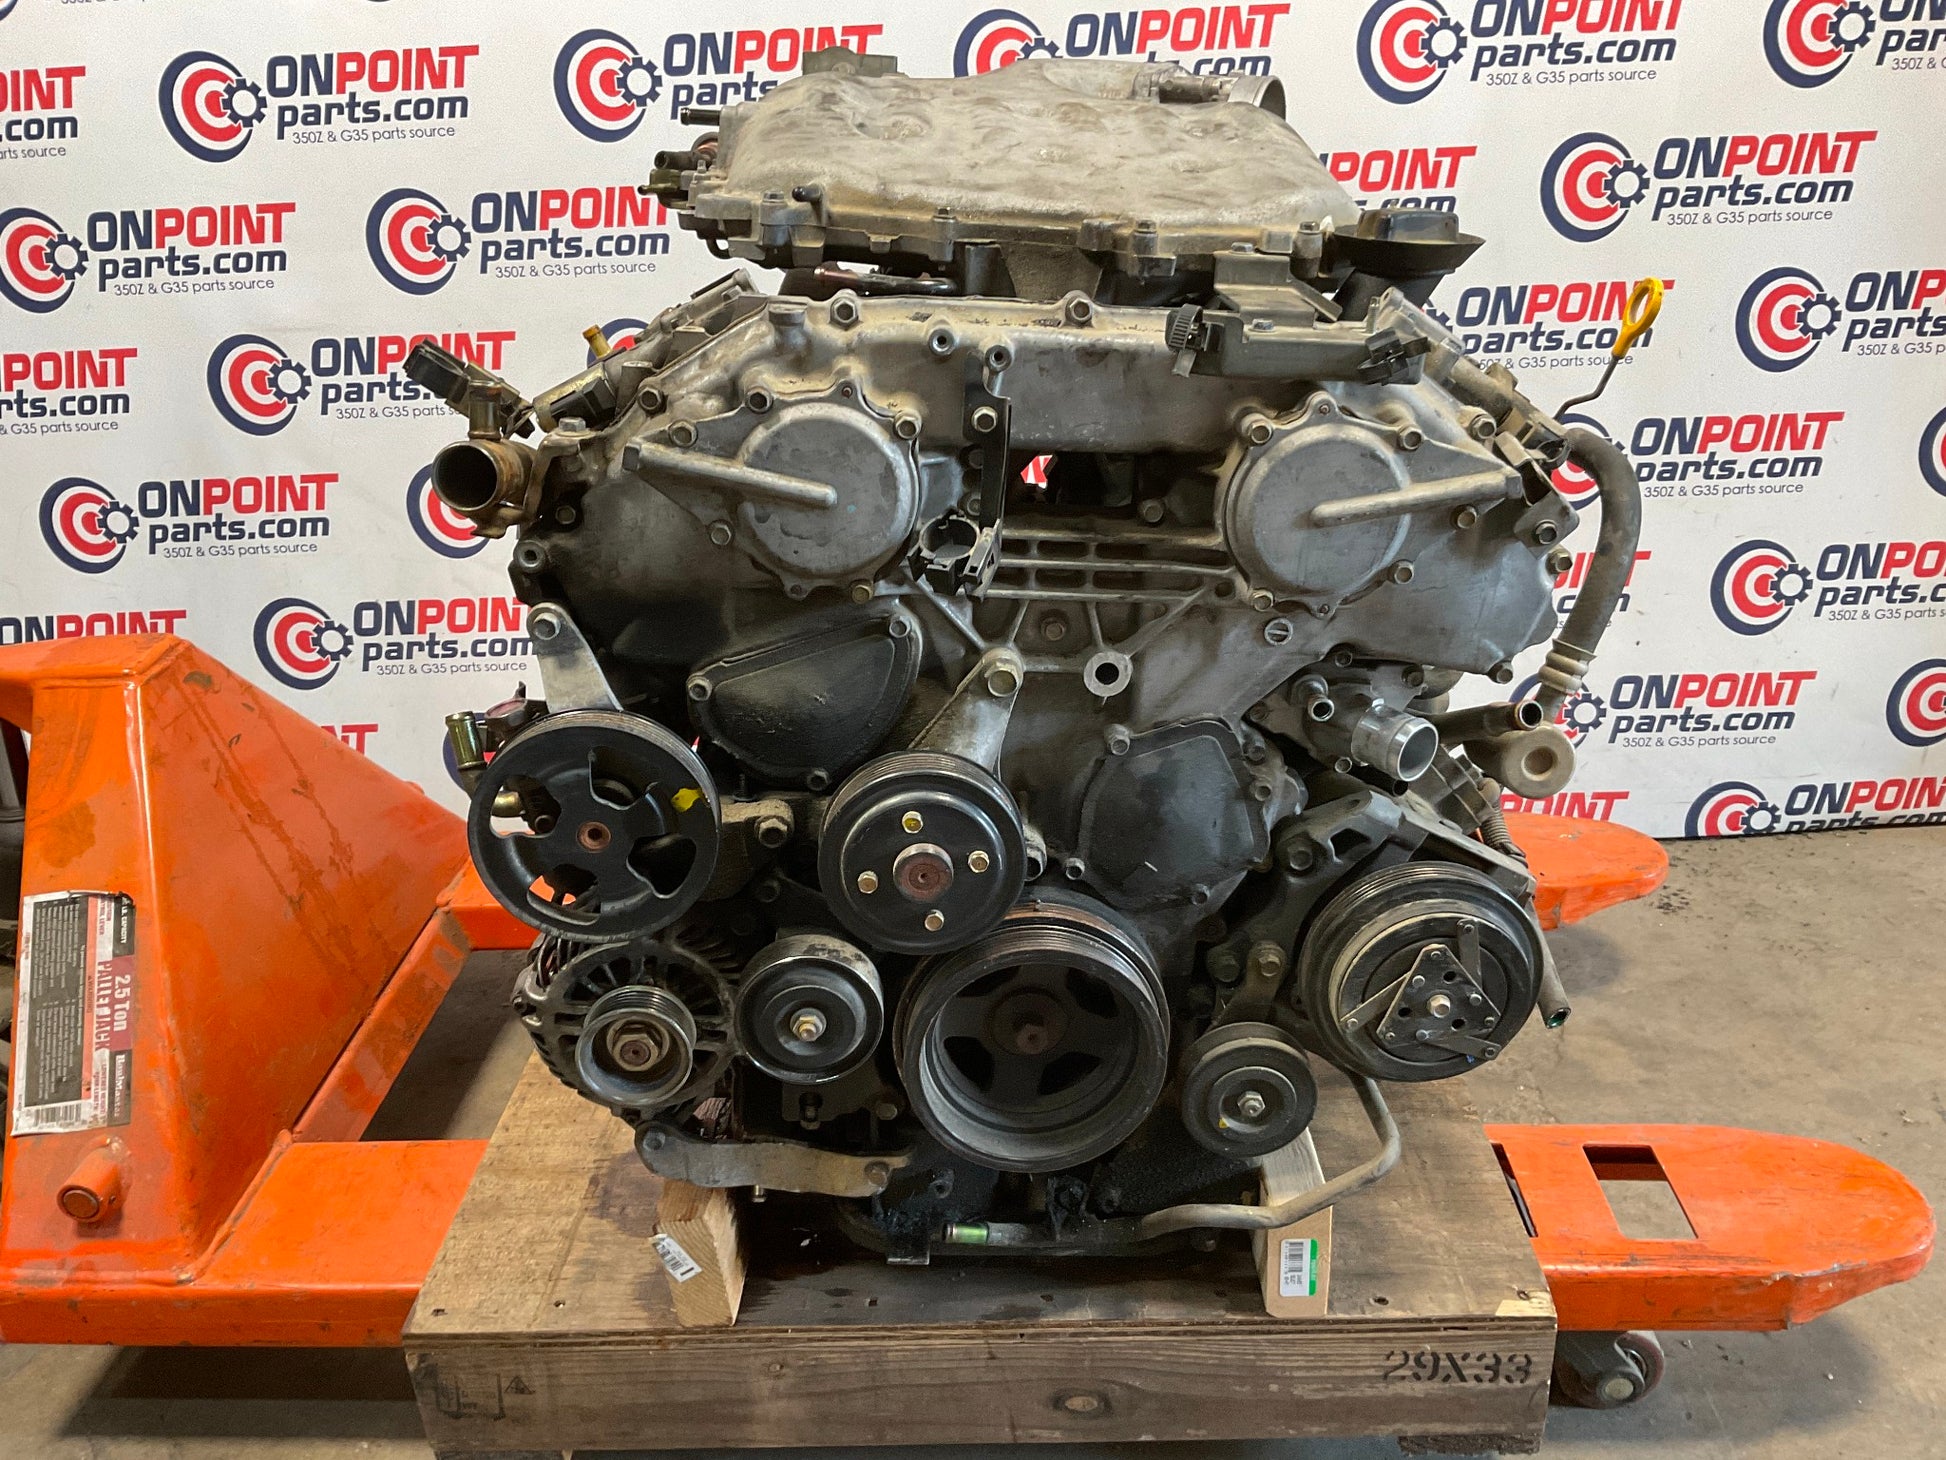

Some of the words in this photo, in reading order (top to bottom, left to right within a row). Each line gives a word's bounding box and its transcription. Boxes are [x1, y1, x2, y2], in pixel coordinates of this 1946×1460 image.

[1065, 3, 1291, 57] ONPOINT
[266, 44, 479, 98] ONPOINT
[1470, 32, 1677, 82] parts.com
[1892, 57, 1923, 70] 350Z
[1486, 73, 1518, 86] 350Z
[1522, 72, 1532, 84] &
[1536, 71, 1565, 84] G35
[1569, 69, 1604, 85] parts
[1608, 69, 1657, 81] source
[277, 92, 468, 140] parts.com
[22, 146, 66, 159] source
[292, 131, 323, 144] 350Z
[327, 130, 337, 142] &
[340, 128, 369, 142] G35
[372, 127, 406, 145] parts
[409, 126, 455, 138] source
[1319, 146, 1478, 192] POINT
[1653, 130, 1878, 179] ONPOINT
[1651, 174, 1854, 221] parts.com
[87, 202, 296, 252] ONPOINT
[1667, 213, 1699, 225] 350Z
[1703, 212, 1712, 224] &
[1716, 211, 1744, 224] G35
[1748, 209, 1782, 225] parts
[1786, 210, 1833, 222] source
[99, 246, 287, 292] parts.com
[480, 228, 670, 275] parts.com
[114, 283, 144, 296] 350Z
[148, 282, 158, 294] &
[160, 281, 189, 294] G35
[192, 280, 226, 297] parts
[229, 278, 274, 291] source
[496, 266, 525, 278] 350Z
[529, 266, 539, 277] &
[542, 264, 570, 277] G35
[574, 262, 607, 278] parts
[611, 262, 656, 274] source
[1505, 357, 1515, 369] &
[1518, 356, 1546, 368] G35
[1550, 355, 1584, 370] parts
[1857, 344, 1888, 356] 350Z
[1891, 343, 1899, 354] &
[1904, 342, 1933, 354] G35
[11, 423, 37, 435] G35
[40, 421, 72, 436] parts
[75, 421, 118, 432] source
[336, 408, 366, 419] 350Z
[369, 407, 379, 417] &
[382, 406, 409, 417] G35
[413, 405, 445, 419] parts
[1630, 411, 1845, 456] ONPOINT
[138, 473, 339, 518] ONPOINT
[1644, 486, 1674, 498] 350Z
[1678, 486, 1687, 497] &
[1691, 485, 1719, 496] G35
[1722, 484, 1756, 497] parts
[1758, 483, 1804, 494] source
[149, 513, 330, 555] parts.com
[164, 547, 193, 558] 350Z
[196, 546, 205, 556] &
[208, 545, 235, 556] G35
[238, 544, 271, 557] parts
[274, 543, 318, 554] source
[353, 597, 531, 637] ONPOIN
[1828, 609, 1857, 621] 350Z
[1861, 609, 1870, 620] &
[1874, 608, 1902, 620] G35
[1904, 607, 1936, 620] parts
[362, 632, 537, 672] parts.com
[376, 665, 404, 676] 350Z
[409, 664, 417, 674] &
[421, 663, 447, 673] G35
[450, 662, 481, 675] parts
[484, 662, 527, 672] source
[1609, 671, 1818, 710] ONPOINT
[1607, 706, 1795, 743] parts.com
[1622, 737, 1652, 748] 350Z
[1655, 737, 1664, 747] &
[1668, 736, 1695, 746] G35
[1698, 735, 1730, 748] parts
[1733, 735, 1776, 745] source
[96, 960, 113, 1010] PALLET
[114, 974, 131, 999] 2.5
[95, 1013, 112, 1052] JACK
[113, 1000, 130, 1032] Ton
[1383, 1350, 1533, 1384] 29X33
